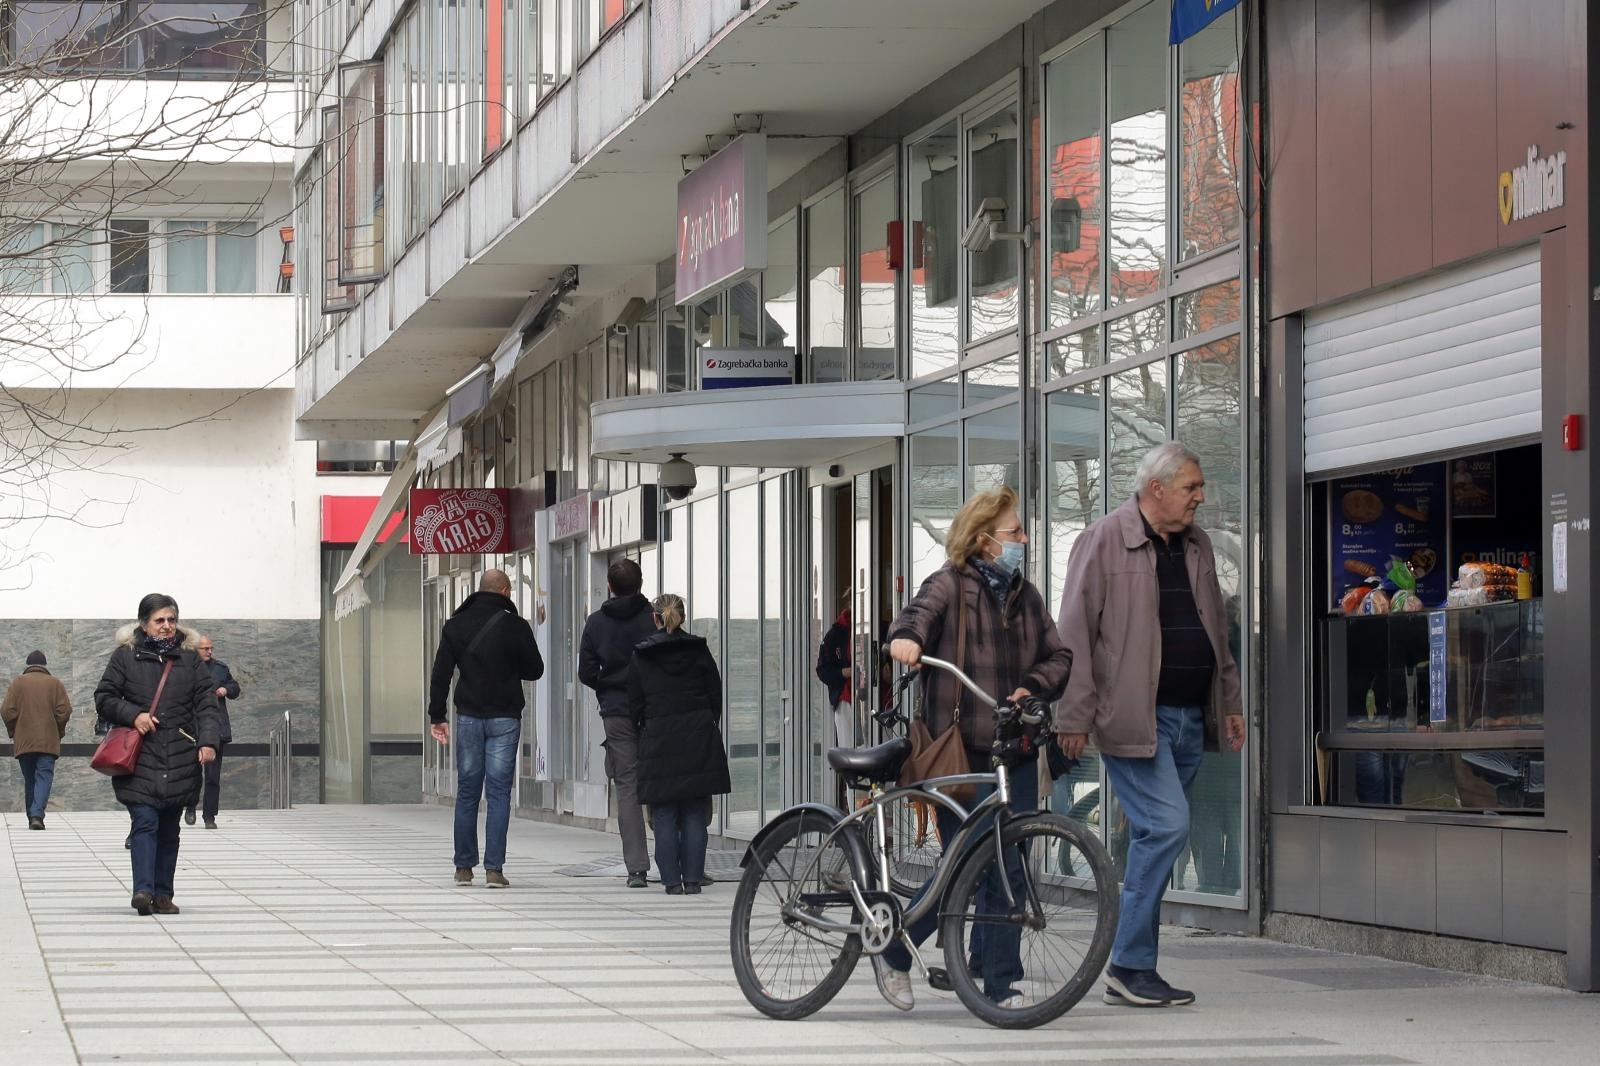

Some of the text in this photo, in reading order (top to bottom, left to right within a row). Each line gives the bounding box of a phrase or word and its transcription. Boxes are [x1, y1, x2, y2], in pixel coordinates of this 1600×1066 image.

[1512, 144, 1567, 221] mlinar
[717, 358, 789, 370] Zagrebačka banka
[436, 510, 492, 553] KRAŠ
